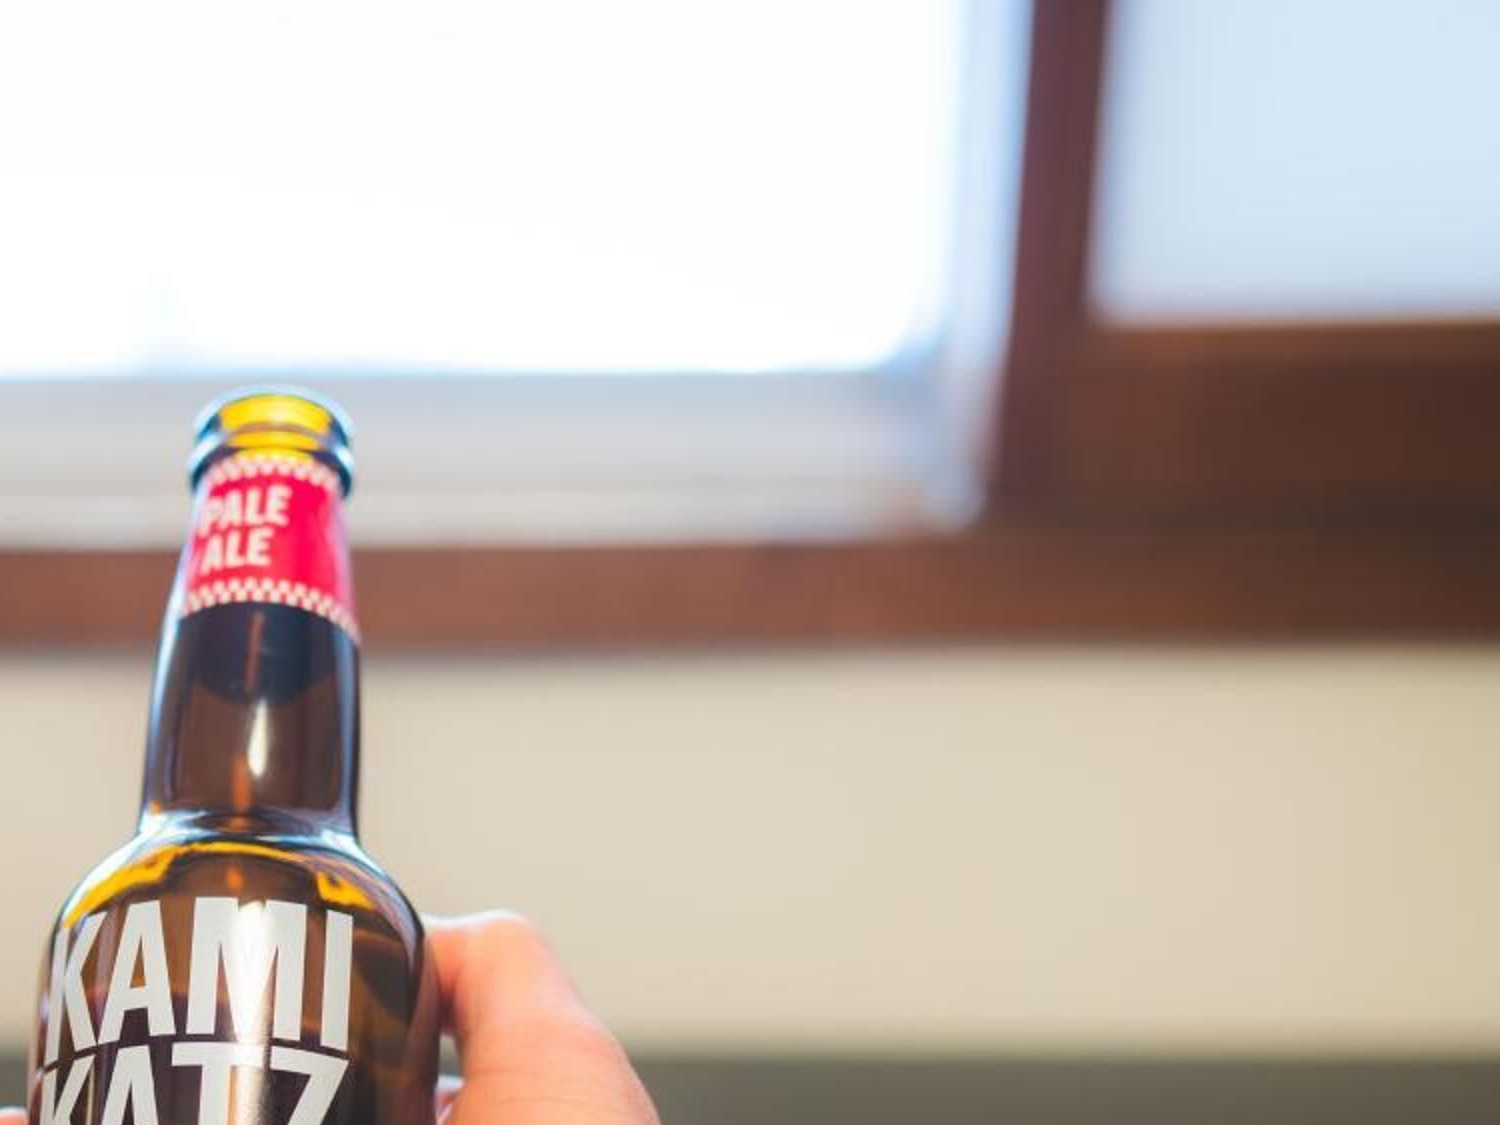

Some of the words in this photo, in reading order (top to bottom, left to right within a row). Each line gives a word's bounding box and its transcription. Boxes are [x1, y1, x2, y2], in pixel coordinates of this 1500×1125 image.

[198, 484, 292, 538] PALE
[200, 527, 274, 575] ALE
[45, 897, 353, 1066] KAMI
